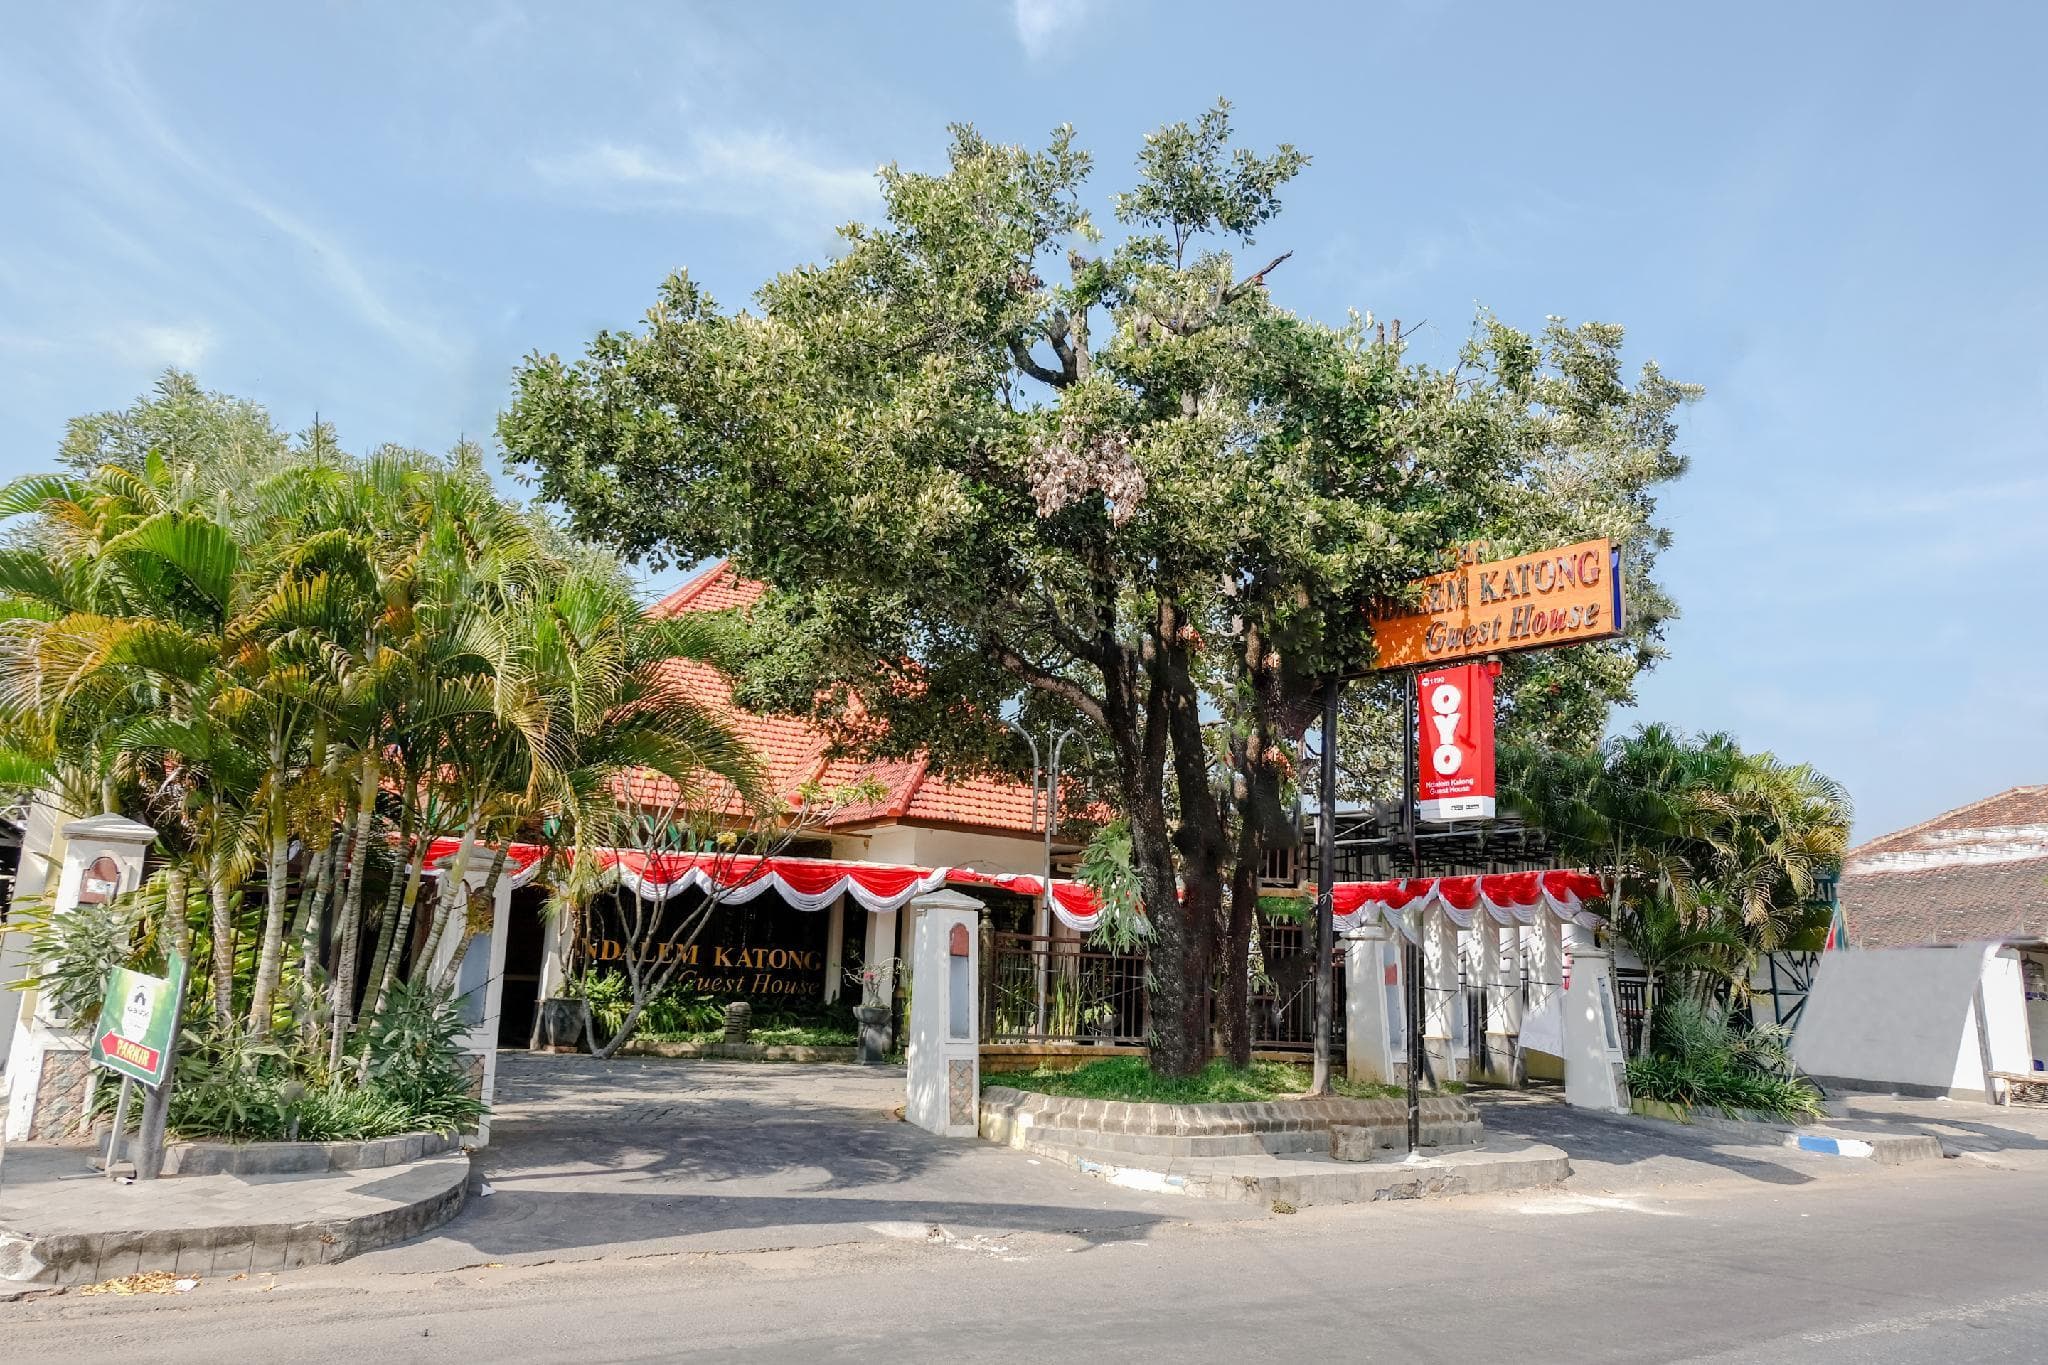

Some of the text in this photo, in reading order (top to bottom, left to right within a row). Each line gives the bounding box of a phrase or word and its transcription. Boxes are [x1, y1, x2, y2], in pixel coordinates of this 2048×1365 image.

[1479, 549, 1601, 605] KATONG
[1425, 602, 1601, 653] Guest House
[1431, 684, 1462, 776] OYO
[713, 946, 821, 971] KATONG
[751, 973, 820, 995] House
